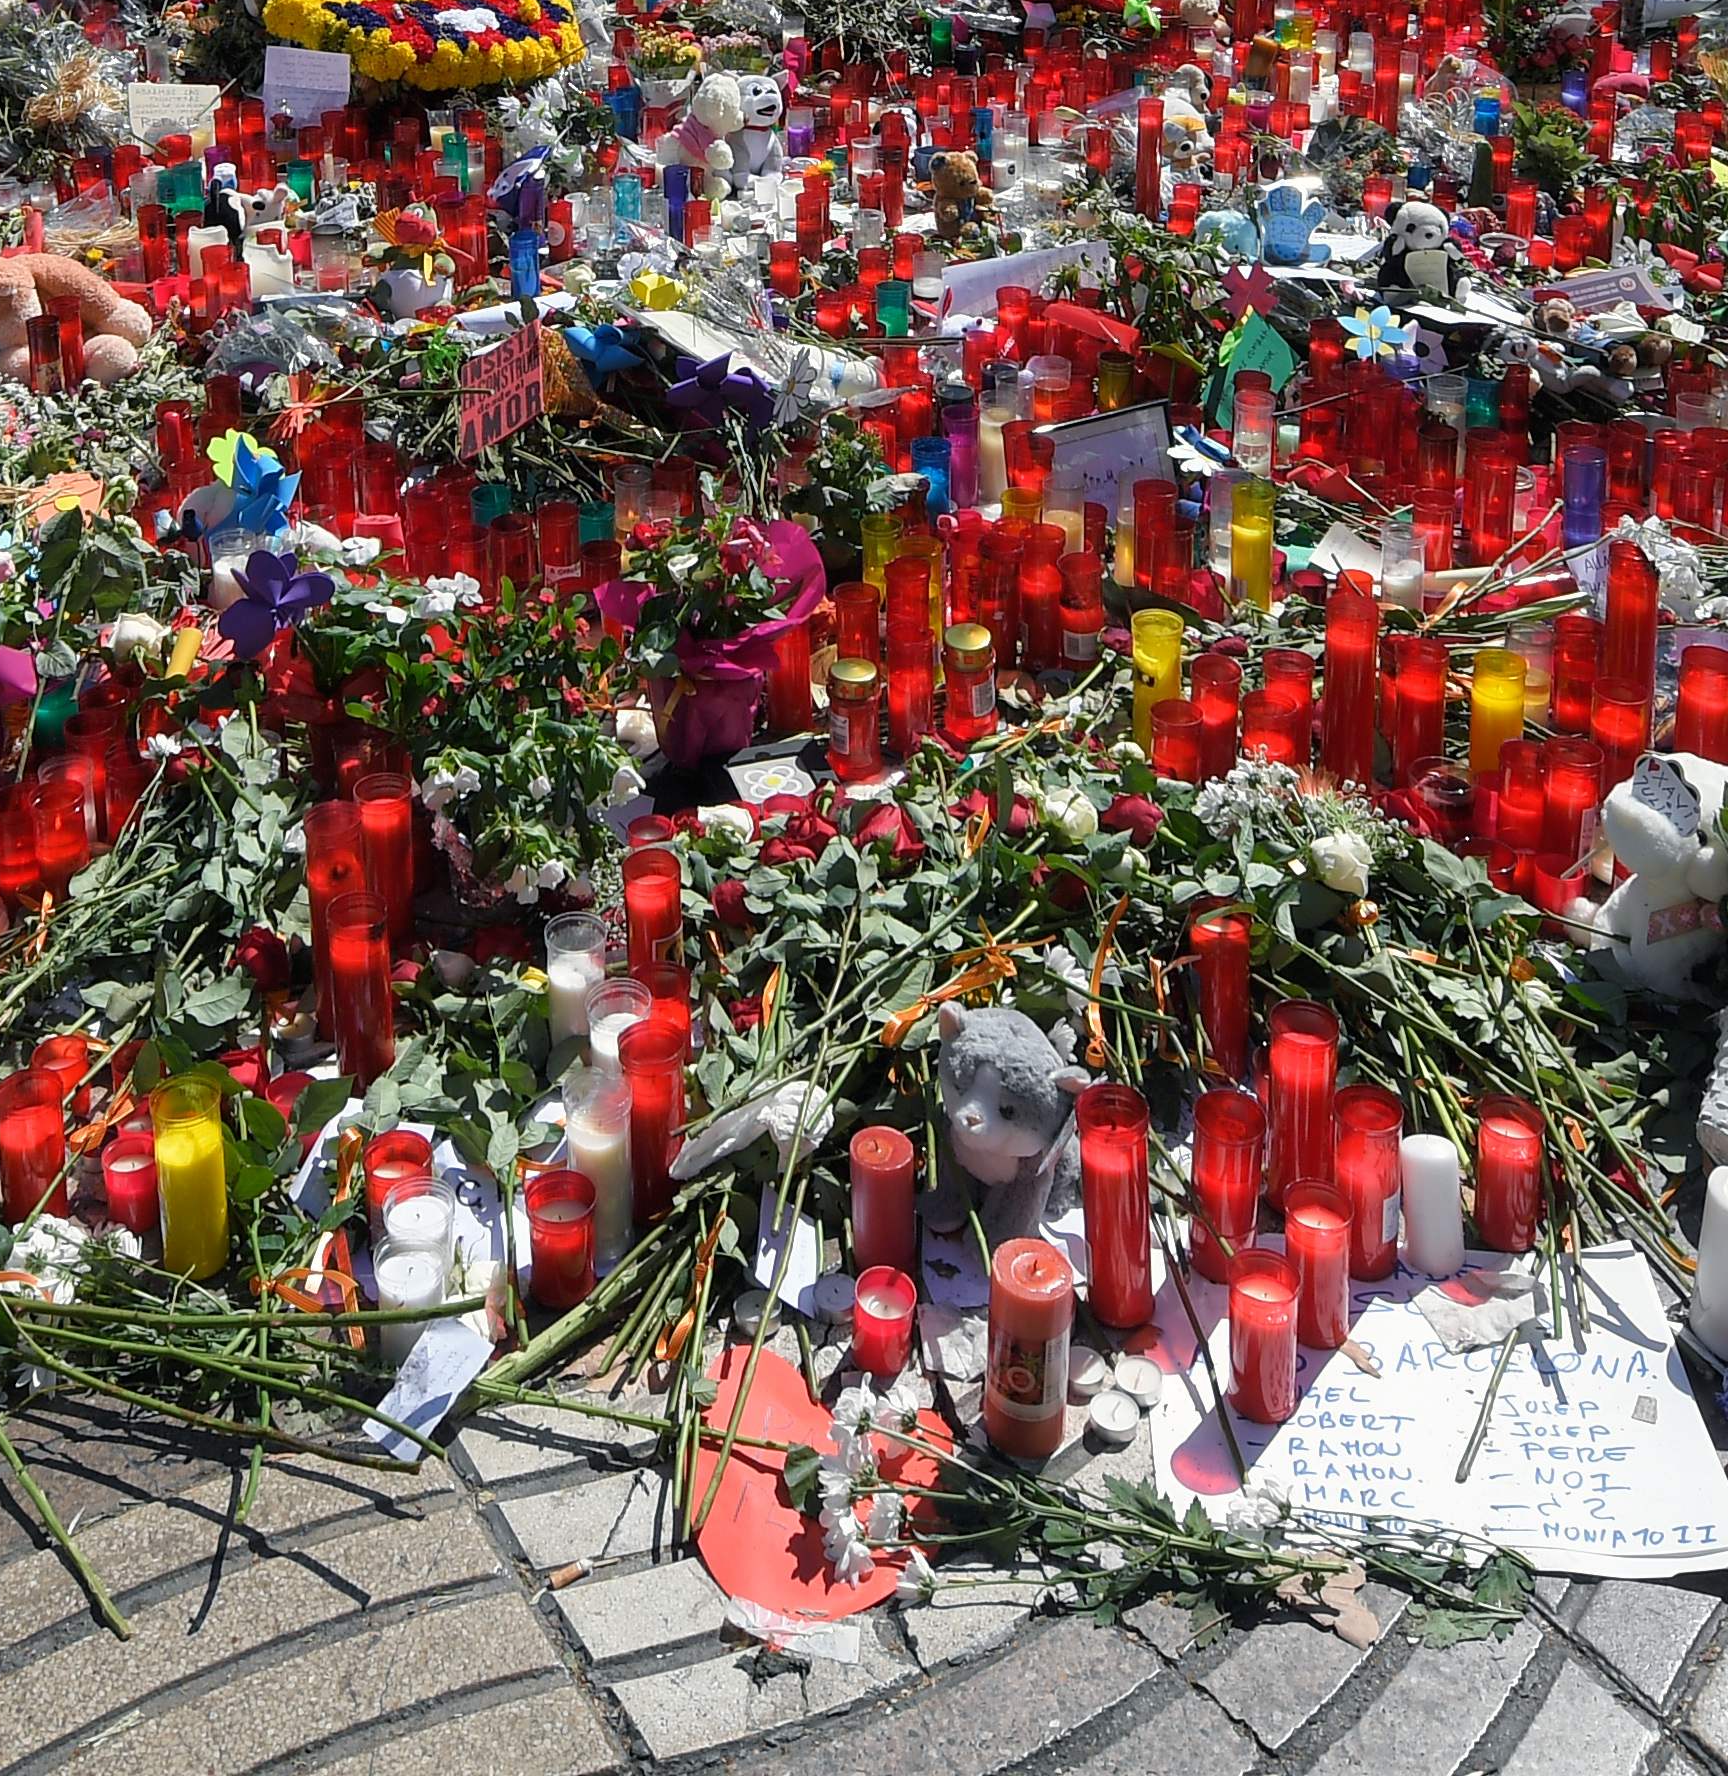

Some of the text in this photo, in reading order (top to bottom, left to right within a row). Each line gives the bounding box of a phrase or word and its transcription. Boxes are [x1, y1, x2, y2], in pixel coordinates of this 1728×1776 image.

[463, 380, 541, 457] AMOR
[1651, 770, 1694, 821] XAVI
[1497, 1393, 1601, 1419] JOSEP
[1509, 1421, 1612, 1443] JOSEP
[1289, 1436, 1402, 1458] RAMON
[1520, 1442, 1636, 1464] PERE
[1535, 1466, 1632, 1493] NOI
[1304, 1483, 1416, 1509] MARC
